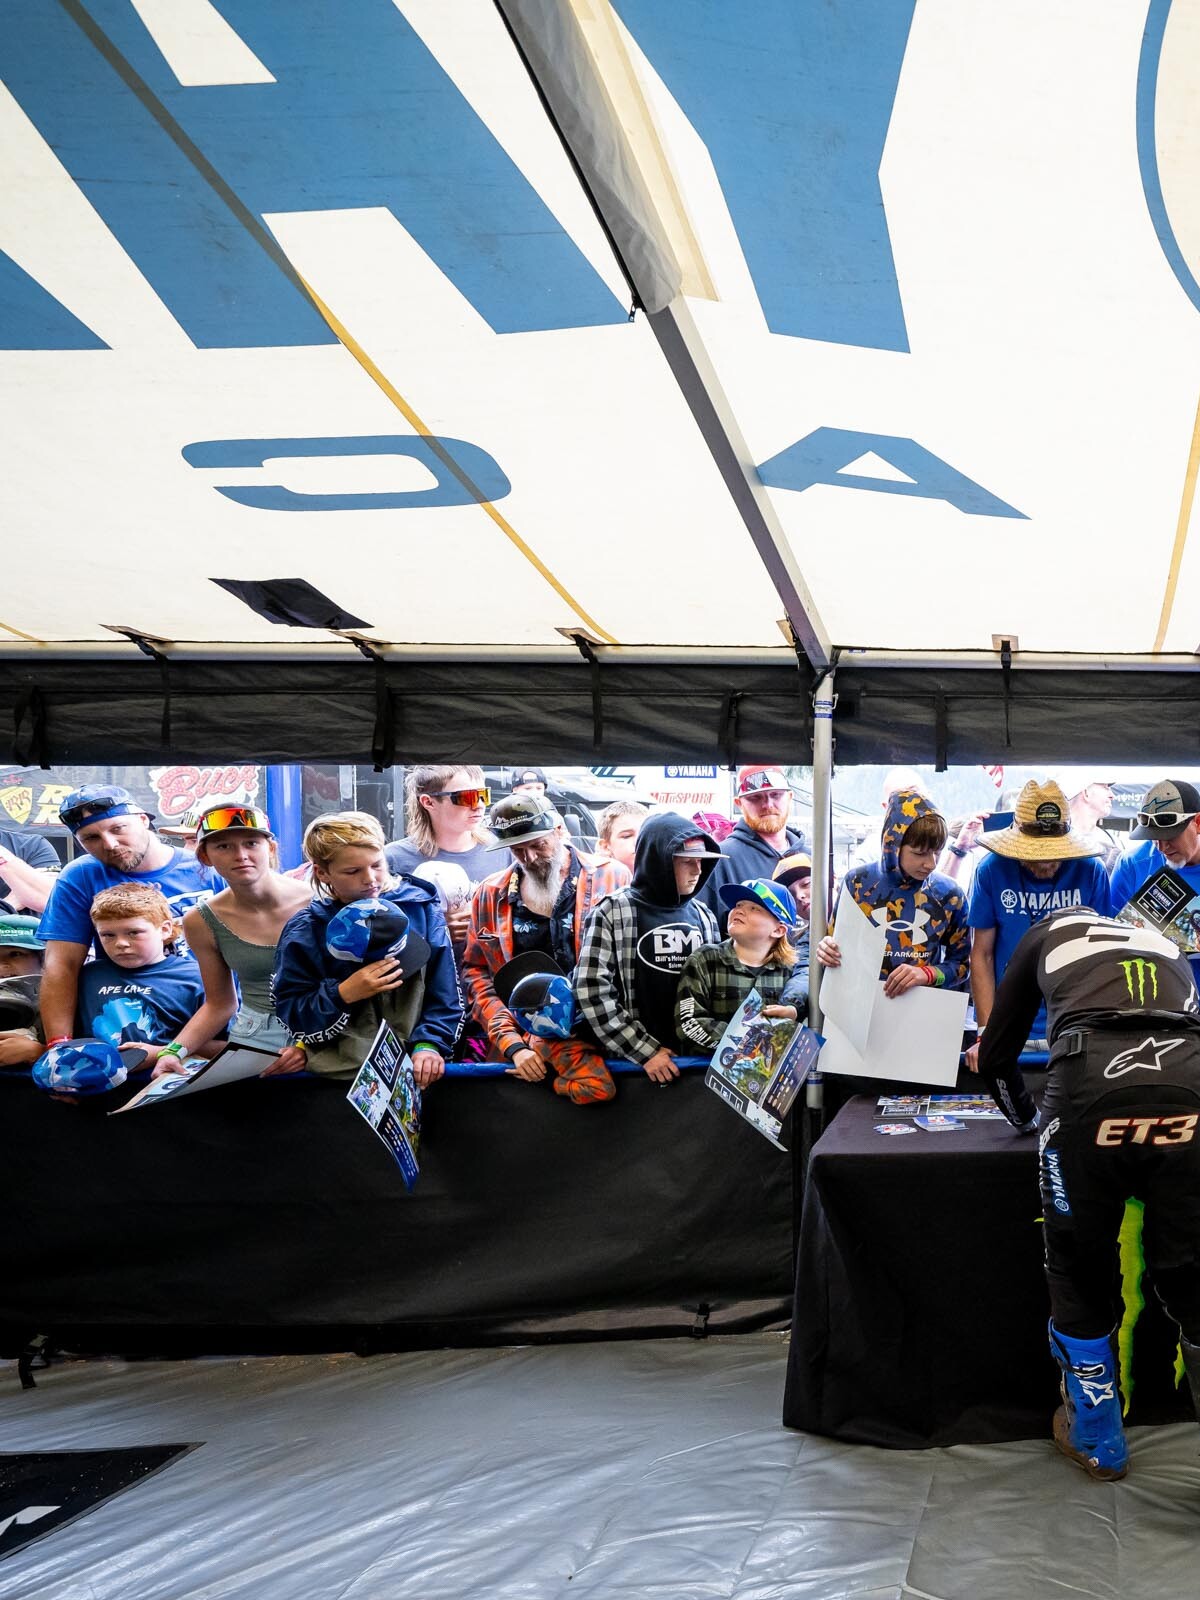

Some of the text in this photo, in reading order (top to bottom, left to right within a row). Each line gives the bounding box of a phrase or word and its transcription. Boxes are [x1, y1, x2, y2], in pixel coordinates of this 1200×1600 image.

[677, 766, 715, 777] YAMAHA
[1018, 889, 1082, 909] YAMAHA
[98, 985, 152, 995] APE CAVE
[680, 997, 712, 1047] DIRTY SEAGULL
[1095, 1114, 1199, 1147] ET3
[1046, 1152, 1066, 1198] YAMAHA
